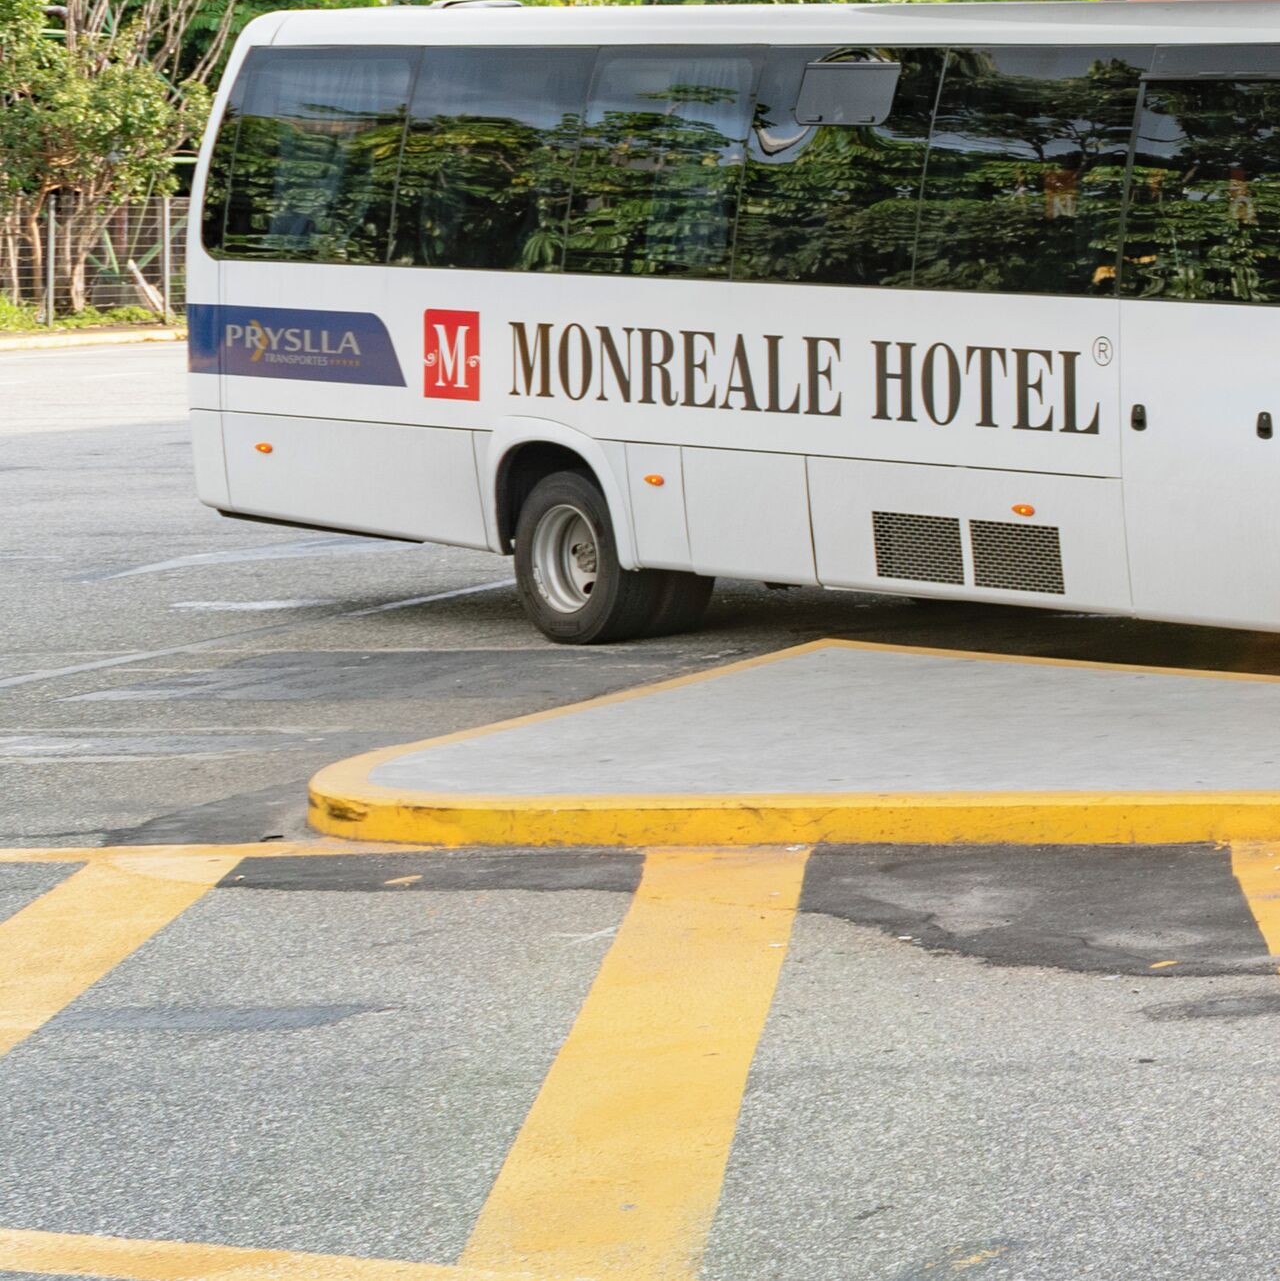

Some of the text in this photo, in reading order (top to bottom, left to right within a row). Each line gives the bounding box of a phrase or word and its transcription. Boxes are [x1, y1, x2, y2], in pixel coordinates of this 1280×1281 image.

[224, 322, 362, 356] PRYSLLA
[264, 352, 329, 367] TRANSPORTES
[507, 321, 842, 418] MONREALE
[869, 340, 1100, 435] HOTEL
